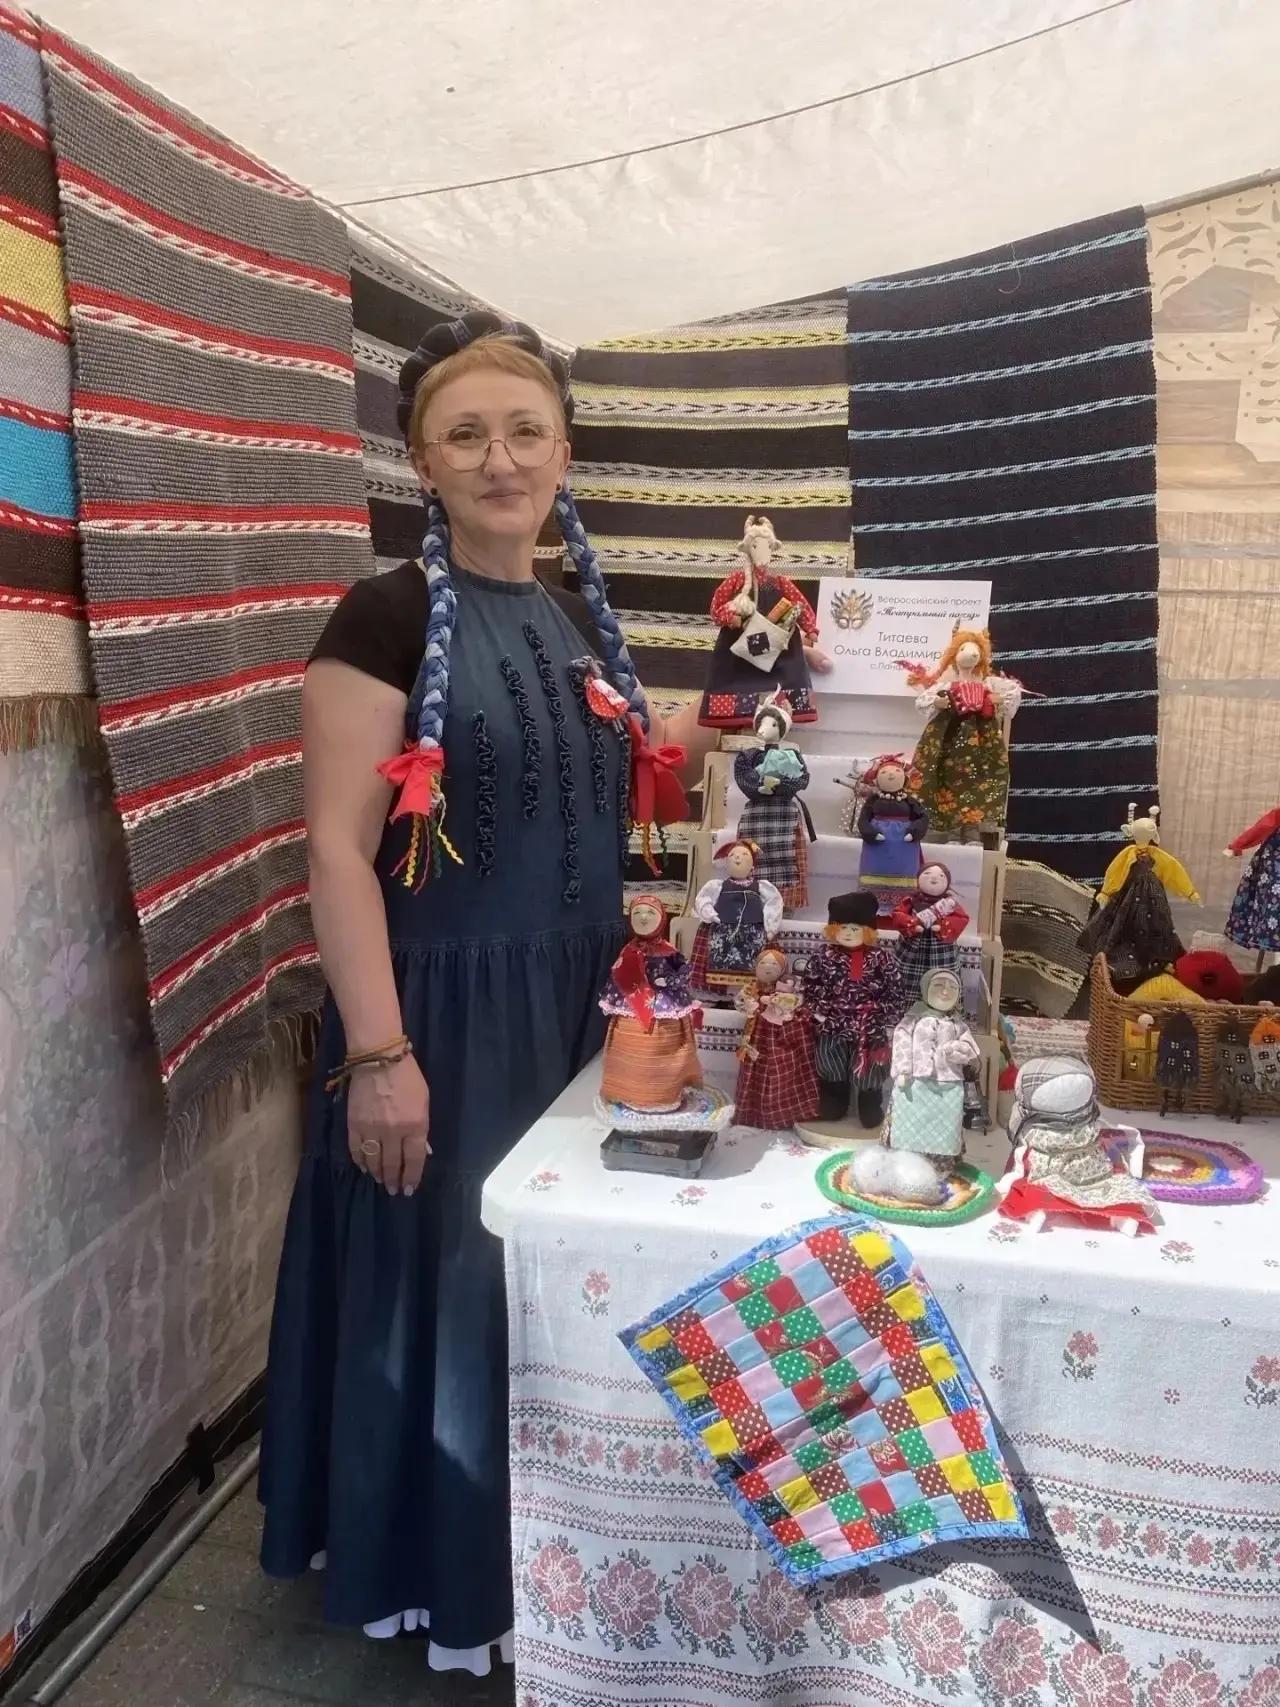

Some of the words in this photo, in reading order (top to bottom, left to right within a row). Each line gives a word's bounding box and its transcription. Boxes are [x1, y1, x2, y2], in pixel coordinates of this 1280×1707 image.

[878, 595, 948, 605] Всероссийский
[878, 631, 928, 644] Титаева
[834, 645, 871, 656] Ольга
[875, 647, 944, 661] Владимир
